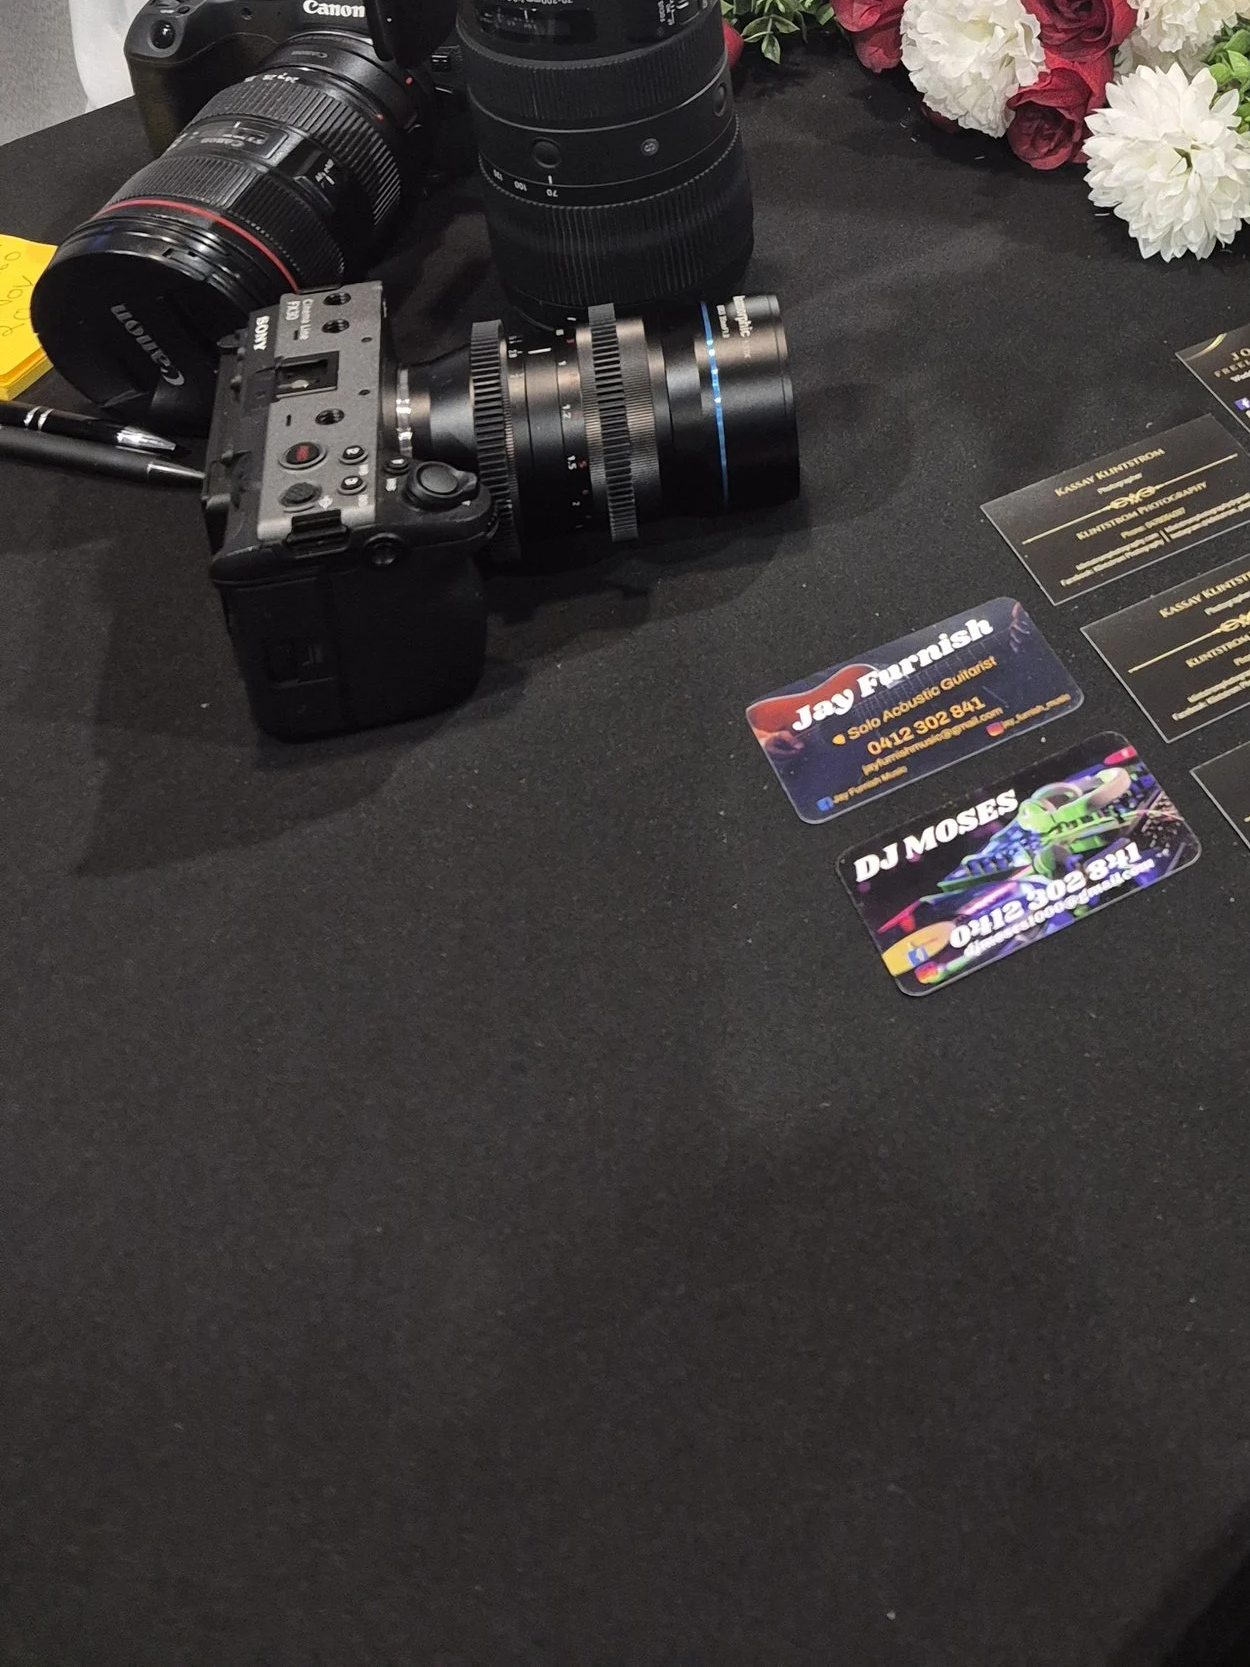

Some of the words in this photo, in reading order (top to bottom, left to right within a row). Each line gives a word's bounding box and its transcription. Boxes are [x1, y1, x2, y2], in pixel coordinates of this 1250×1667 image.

[303, 0, 366, 18] Canon
[545, 188, 558, 197] 70
[110, 302, 185, 386] Canon
[253, 315, 270, 351] SONY
[1054, 469, 1094, 498] KASSAY
[1094, 447, 1166, 481] KLINTSTROM
[1076, 505, 1140, 541] KLINTSTROM
[1137, 481, 1208, 515] PHOTOGRAPHY
[1159, 594, 1202, 618] KASSAY
[792, 687, 855, 733] Jay
[856, 616, 994, 699] Furnish
[1186, 631, 1250, 668] KLINTSTROM
[847, 716, 880, 741] Solo
[881, 687, 941, 726] Acoustic
[940, 655, 998, 702] Guitarist
[866, 726, 914, 756] 0412
[914, 710, 952, 738] 302
[949, 695, 985, 725] 841
[853, 843, 901, 883] DJ
[905, 788, 1020, 862] MOSES
[949, 902, 1022, 950] 0412
[1024, 871, 1084, 917] 302
[1085, 842, 1143, 884] 841
